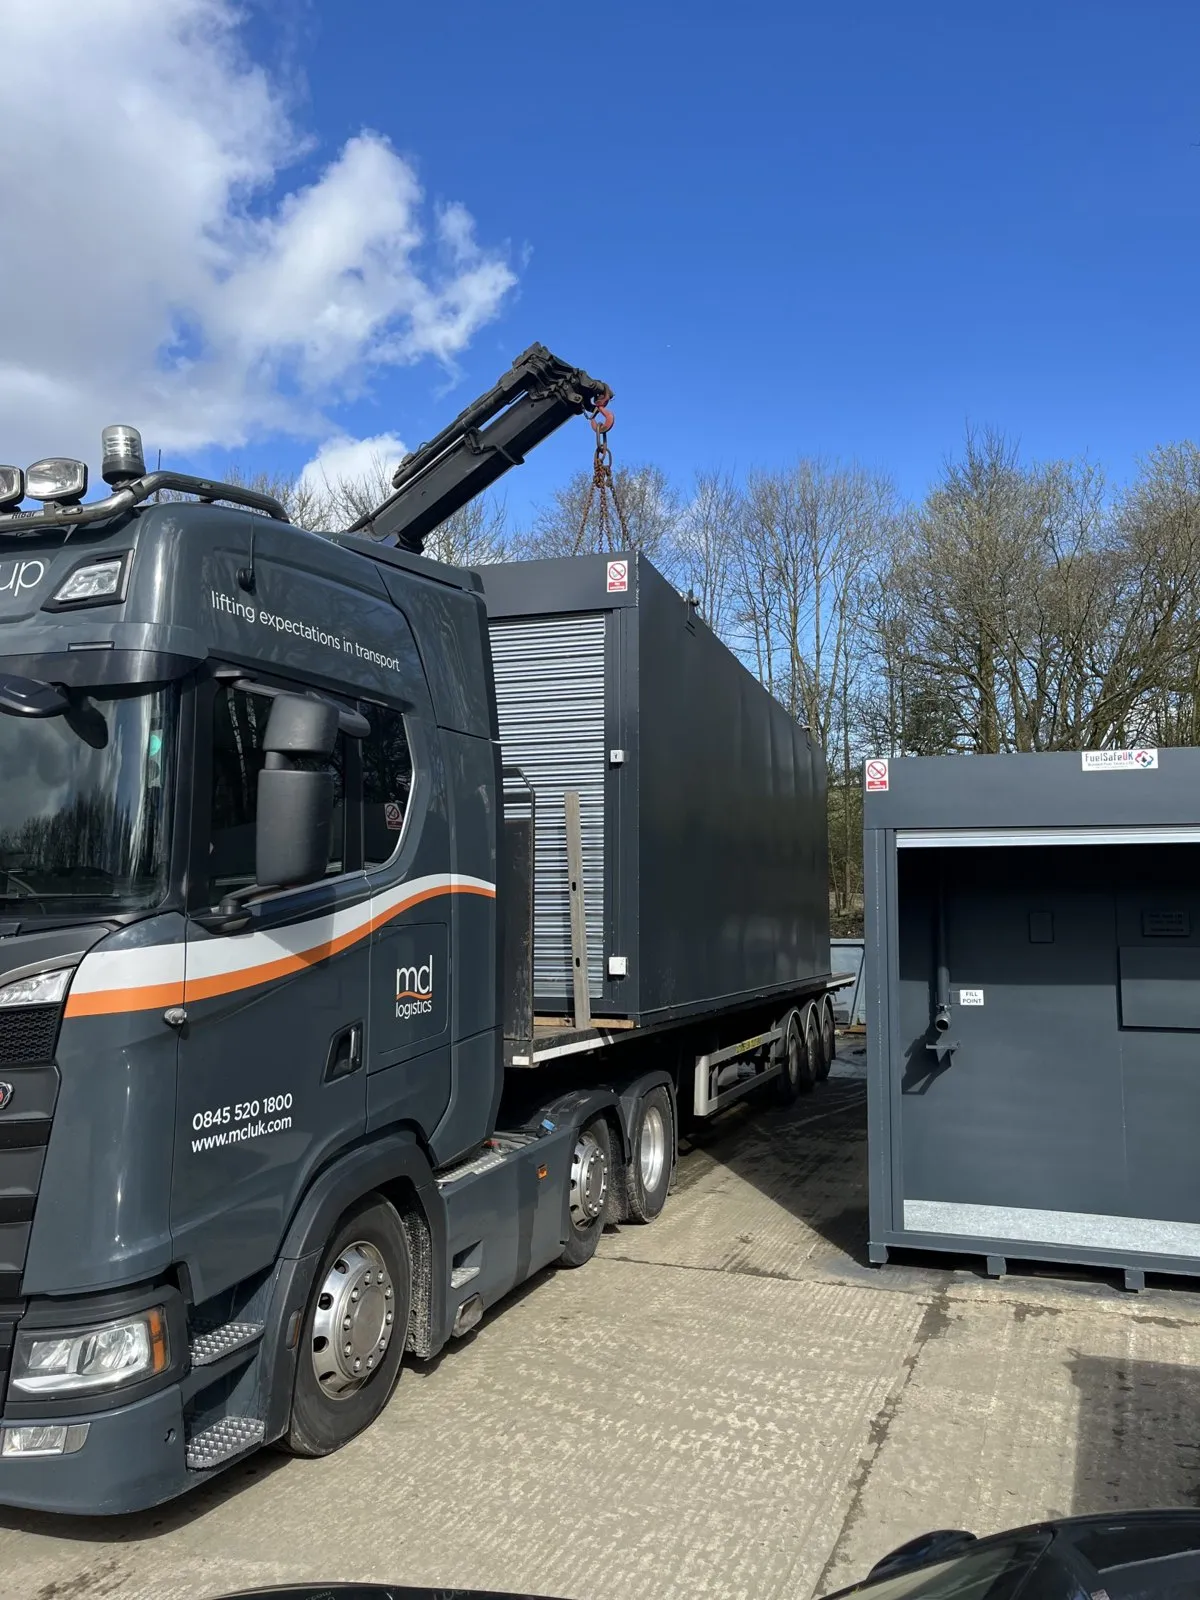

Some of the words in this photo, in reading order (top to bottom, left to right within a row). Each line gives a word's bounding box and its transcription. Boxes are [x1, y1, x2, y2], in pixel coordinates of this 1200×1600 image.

[211, 590, 255, 623] lifting
[259, 610, 341, 650] expectations
[342, 636, 353, 654] in
[355, 643, 400, 672] transport
[1085, 752, 1134, 762] FuelSafeUK
[396, 954, 433, 996] mcl
[395, 999, 432, 1020] logistics
[192, 1106, 231, 1131] 0845
[234, 1100, 260, 1121] 520
[262, 1093, 293, 1114] 1800
[191, 1116, 292, 1153] www.mcluk.com
